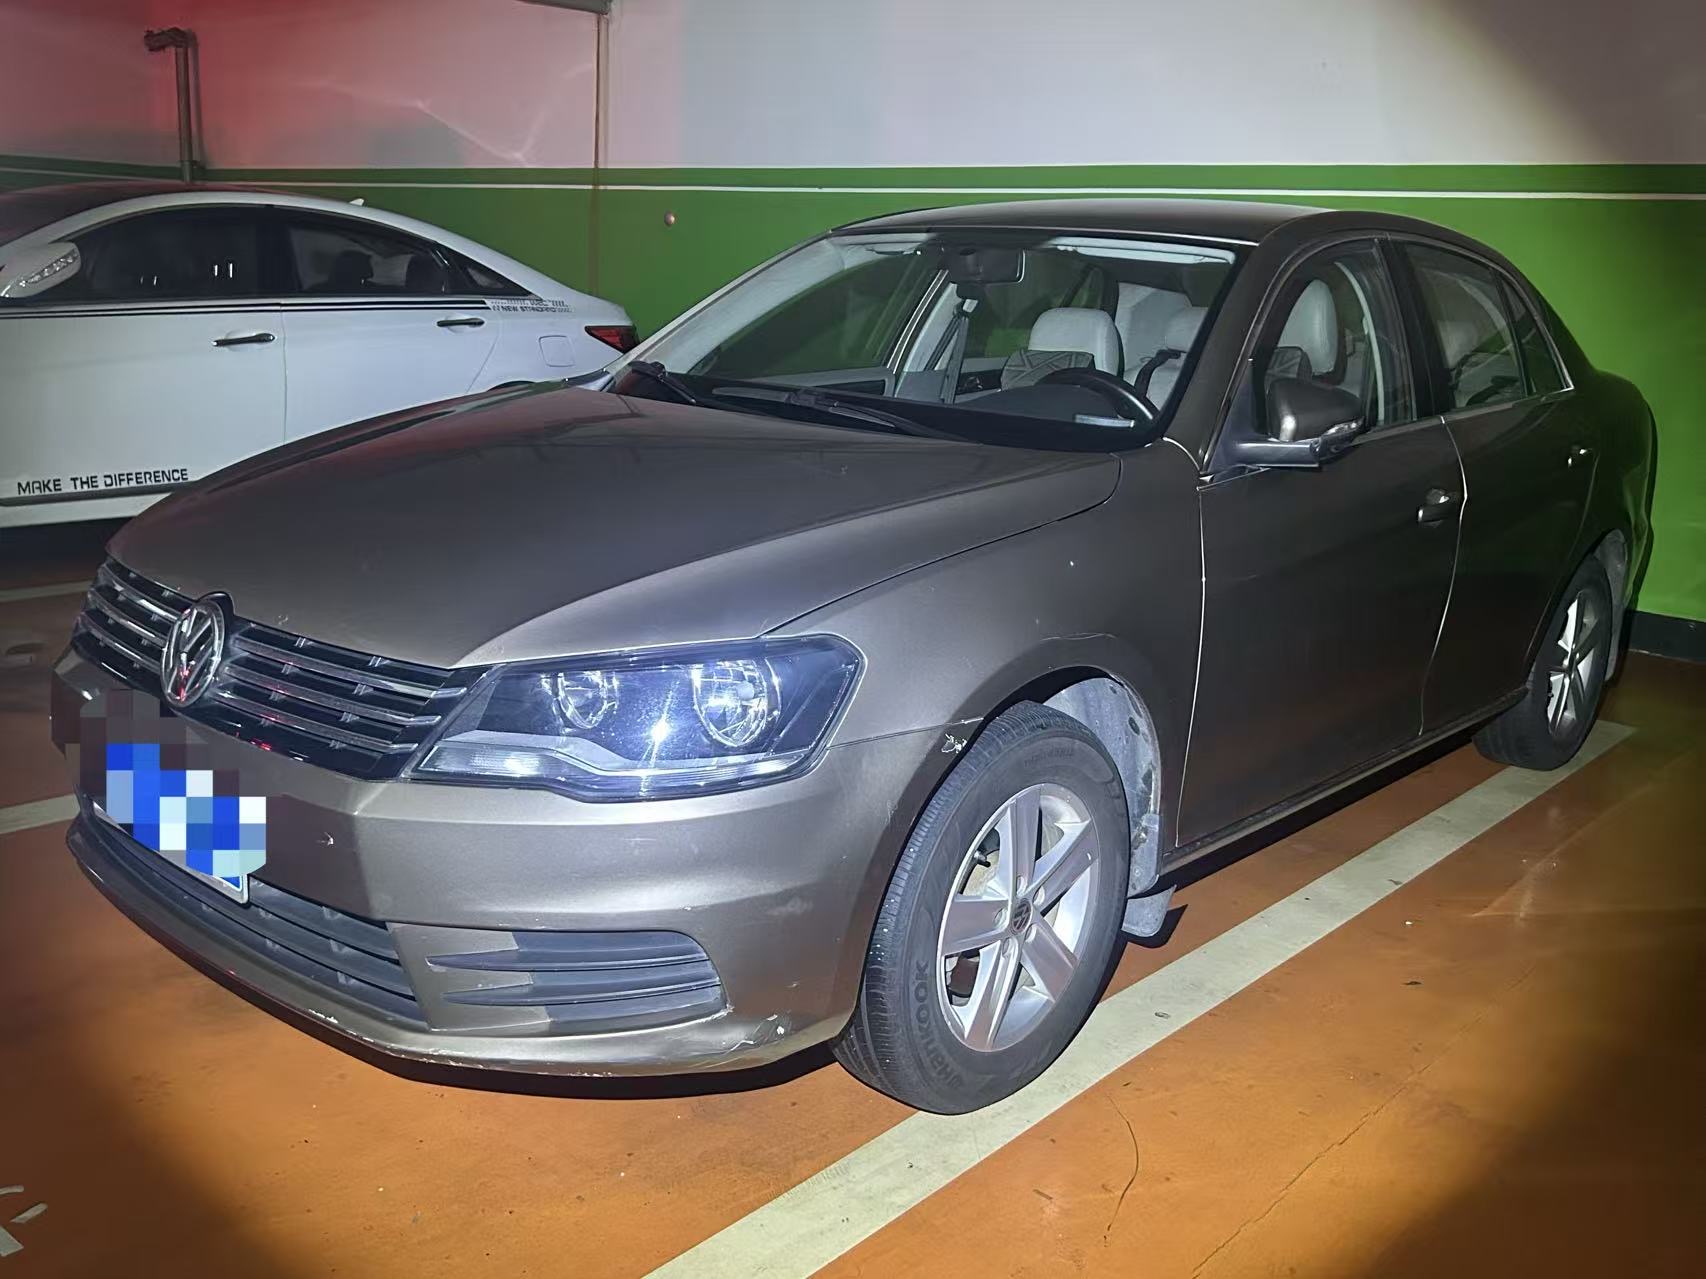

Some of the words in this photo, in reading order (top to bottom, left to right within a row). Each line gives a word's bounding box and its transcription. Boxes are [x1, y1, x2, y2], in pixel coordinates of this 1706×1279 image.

[17, 478, 62, 495] MAKE
[70, 475, 99, 490] THE
[103, 468, 189, 488] DIFFERENCE
